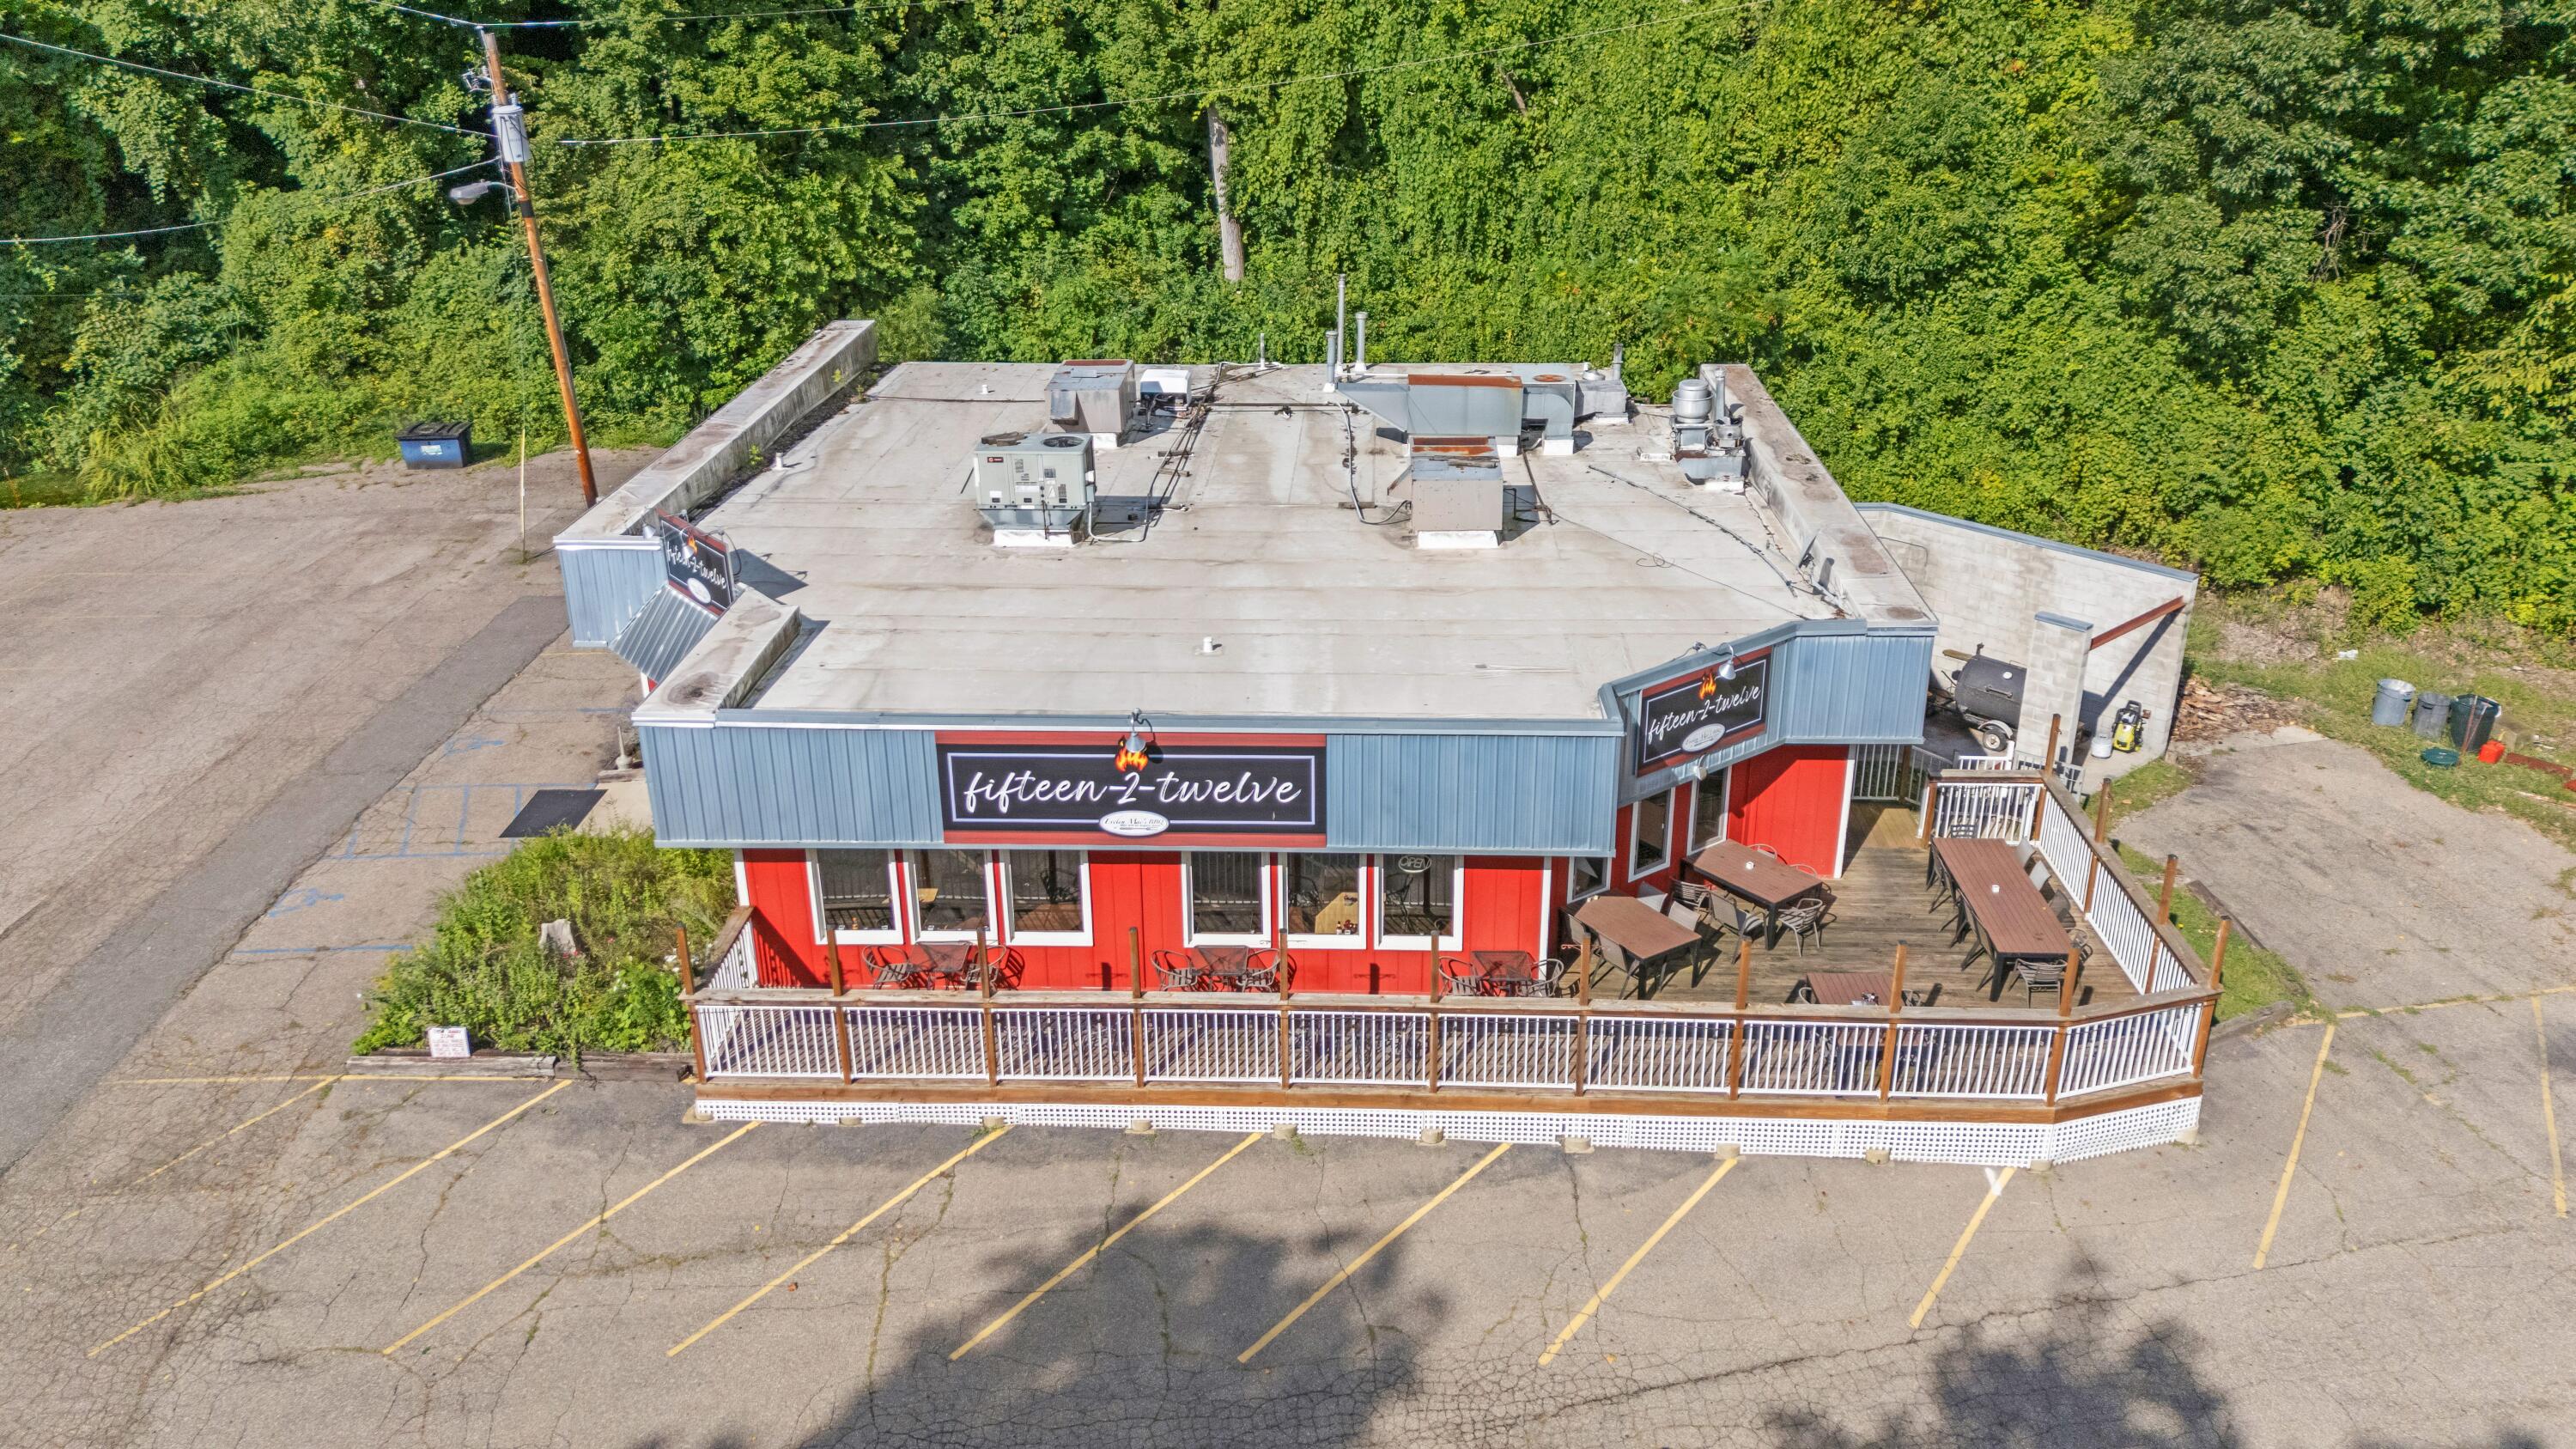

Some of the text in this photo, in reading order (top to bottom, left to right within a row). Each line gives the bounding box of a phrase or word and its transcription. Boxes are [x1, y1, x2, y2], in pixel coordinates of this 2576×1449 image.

[1648, 685, 1761, 745] fifteen-2-twelve
[963, 770, 1302, 813] fifteen-2-twelve
[1400, 856, 1431, 868] OPEN
